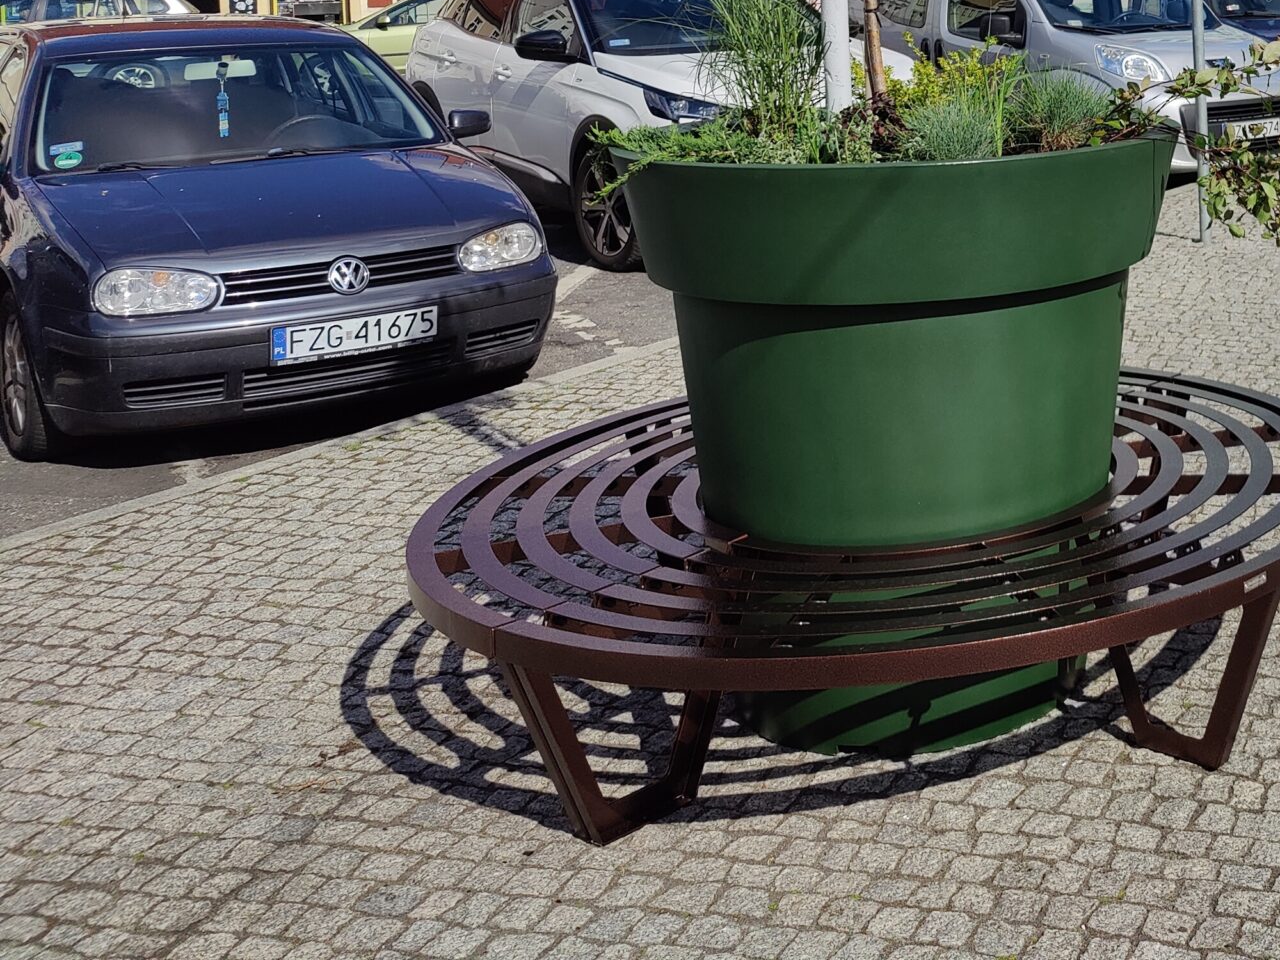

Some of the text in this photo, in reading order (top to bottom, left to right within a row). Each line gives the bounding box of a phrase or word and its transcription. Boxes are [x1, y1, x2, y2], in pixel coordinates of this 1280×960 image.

[289, 308, 434, 355] FZG 41675
[274, 347, 286, 355] PL
